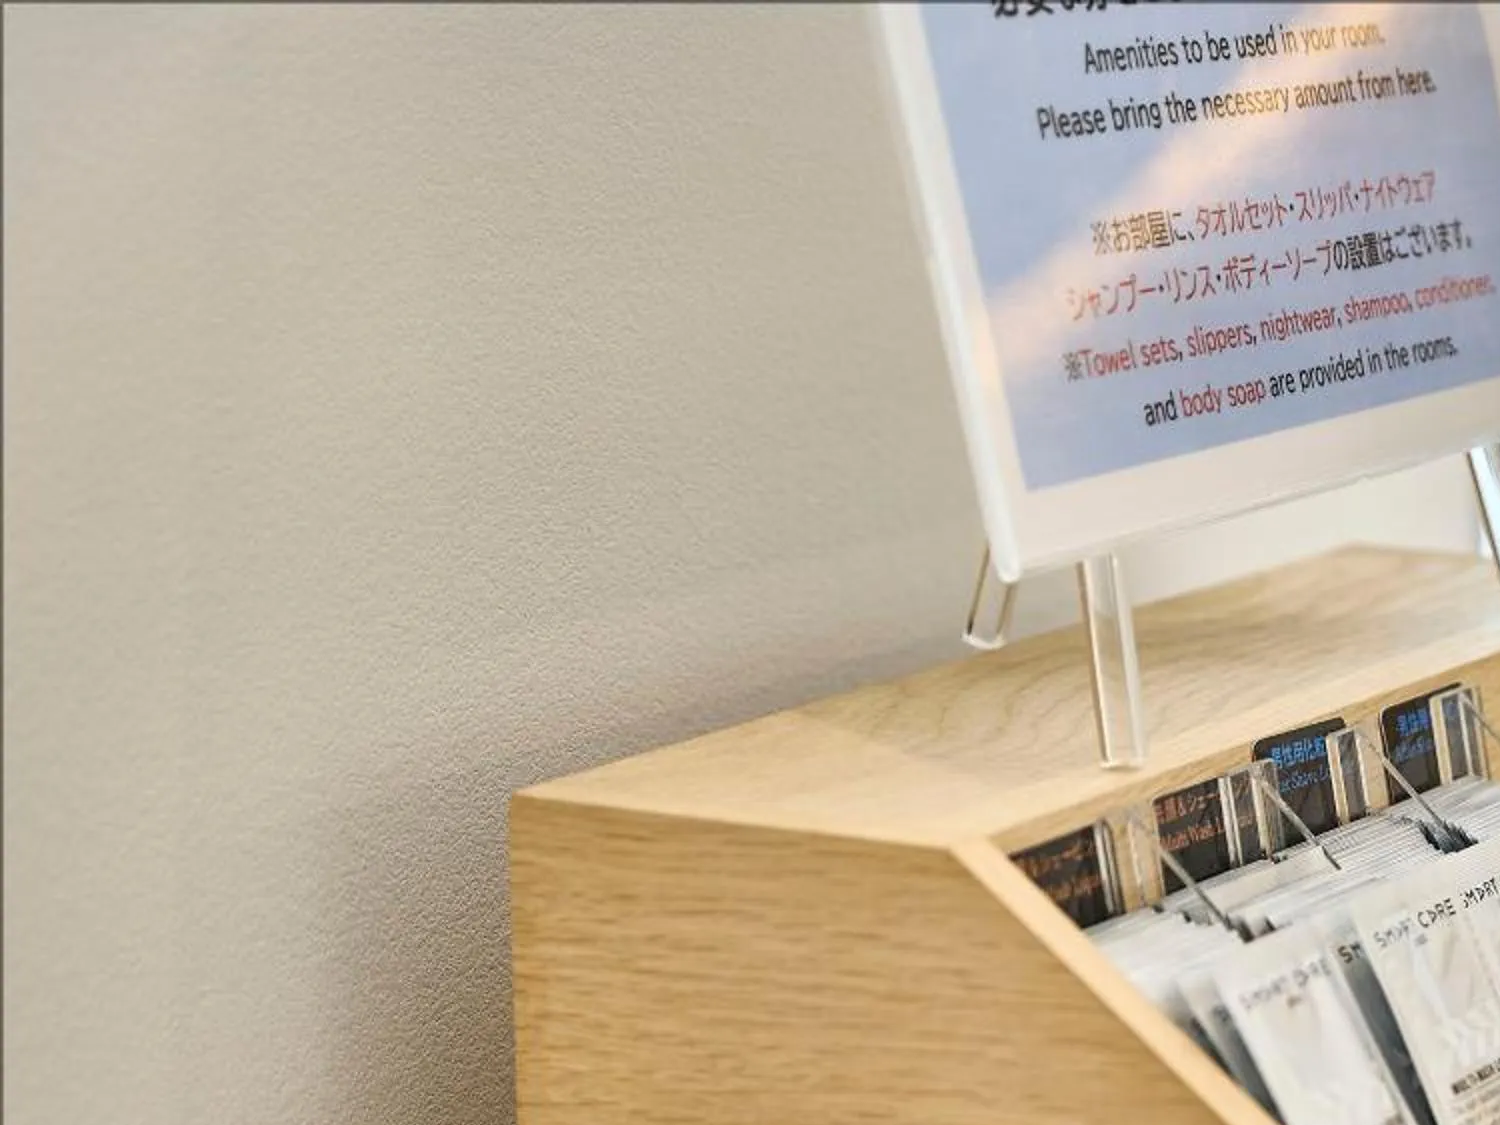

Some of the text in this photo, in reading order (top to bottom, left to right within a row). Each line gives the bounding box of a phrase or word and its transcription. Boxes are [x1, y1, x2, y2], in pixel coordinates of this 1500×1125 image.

[1084, 21, 1386, 74] Amenities to be used in your room.
[1036, 66, 1437, 140] Please bring the necessary amount from here.
[1140, 336, 1183, 367] sets,
[1186, 325, 1258, 359] slippers,
[1260, 304, 1343, 344] nightwear,
[1144, 389, 1179, 427] and
[1180, 384, 1224, 418] body
[1227, 379, 1267, 410] soap
[1269, 371, 1301, 398] are
[1299, 349, 1365, 394] provided
[1366, 347, 1384, 372] in
[1384, 342, 1410, 371] the
